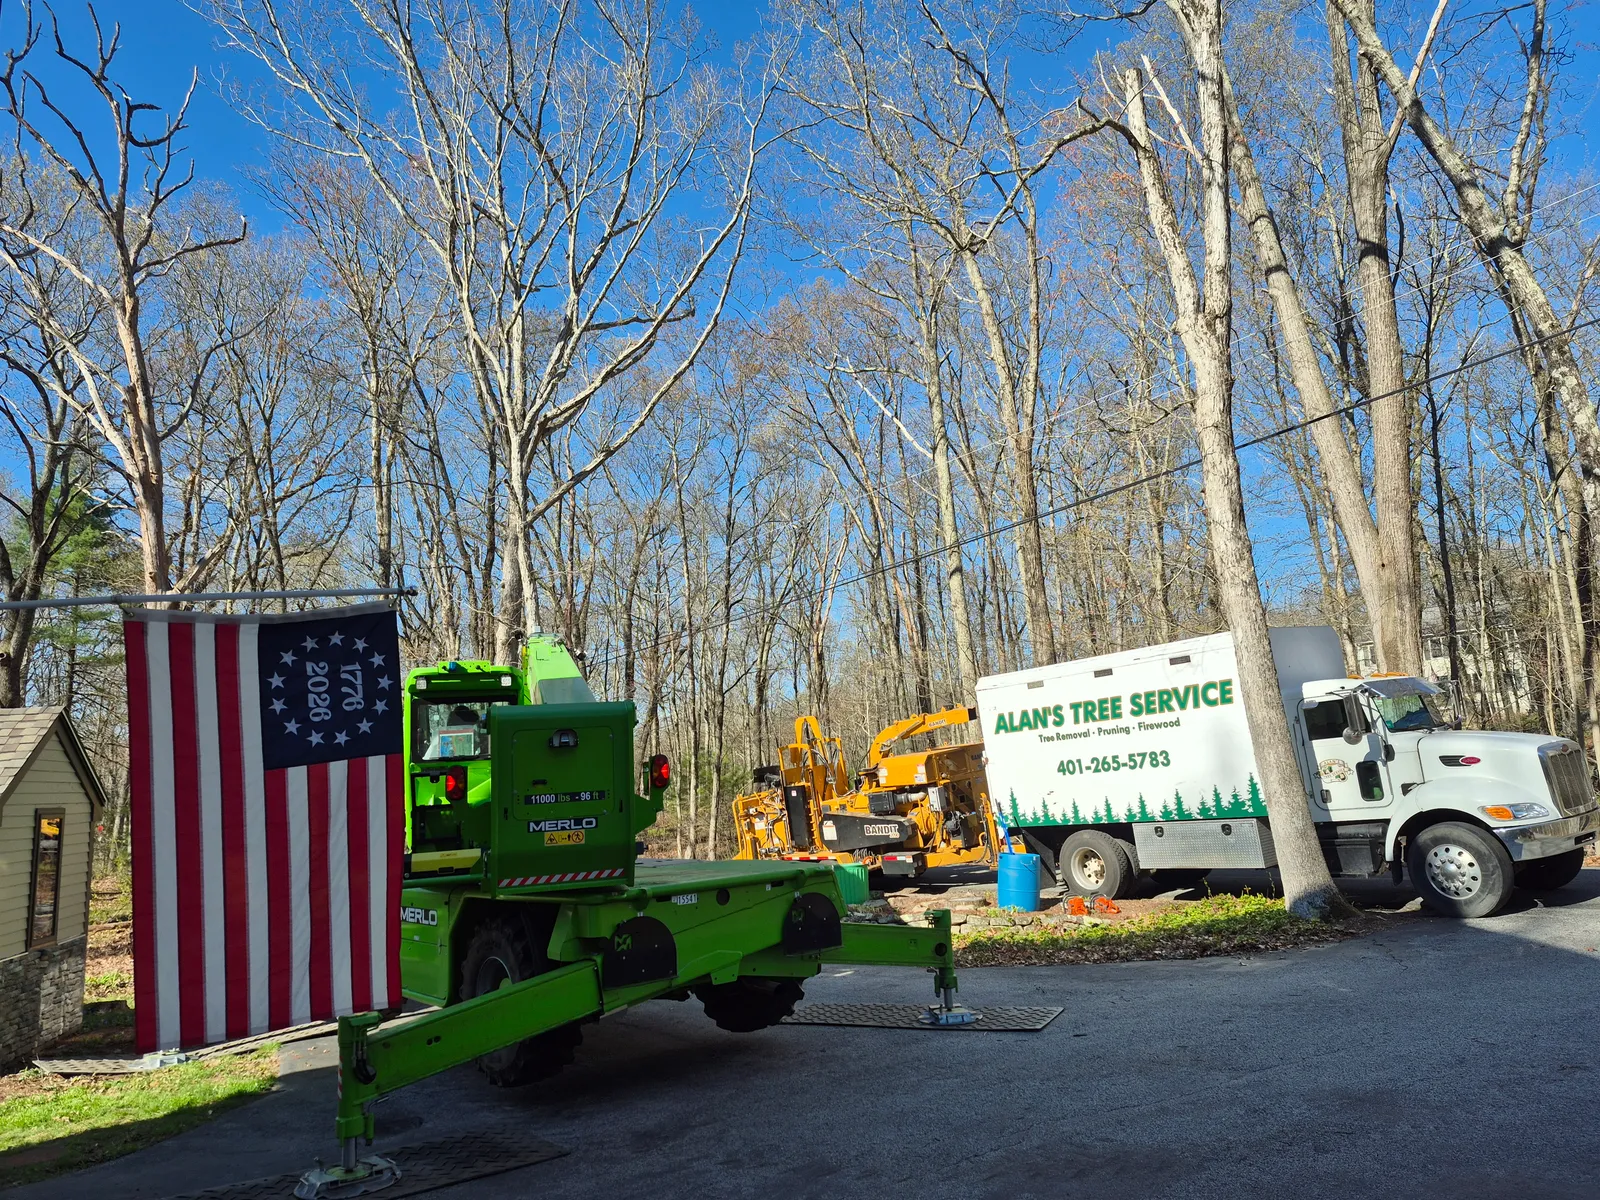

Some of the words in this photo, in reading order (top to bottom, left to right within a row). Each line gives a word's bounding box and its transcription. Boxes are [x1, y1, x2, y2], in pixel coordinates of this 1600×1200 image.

[306, 661, 332, 722] 2026
[340, 662, 364, 711] 1776
[994, 704, 1065, 735] ALAN'S
[1069, 695, 1123, 725] TREE
[1129, 678, 1234, 717] SERVICE
[1038, 734, 1055, 743] Tree
[1056, 729, 1091, 741] Removal
[1097, 725, 1131, 736] Pruning
[1137, 717, 1181, 731] Firewood
[1057, 750, 1171, 776] 401-265-5783
[531, 794, 556, 804] 11000
[557, 793, 571, 802] lbs
[580, 792, 591, 801] 96
[592, 791, 599, 799] ft
[529, 818, 597, 832] MERLO
[864, 824, 899, 835] BANDIT
[400, 906, 438, 926] MERLO
